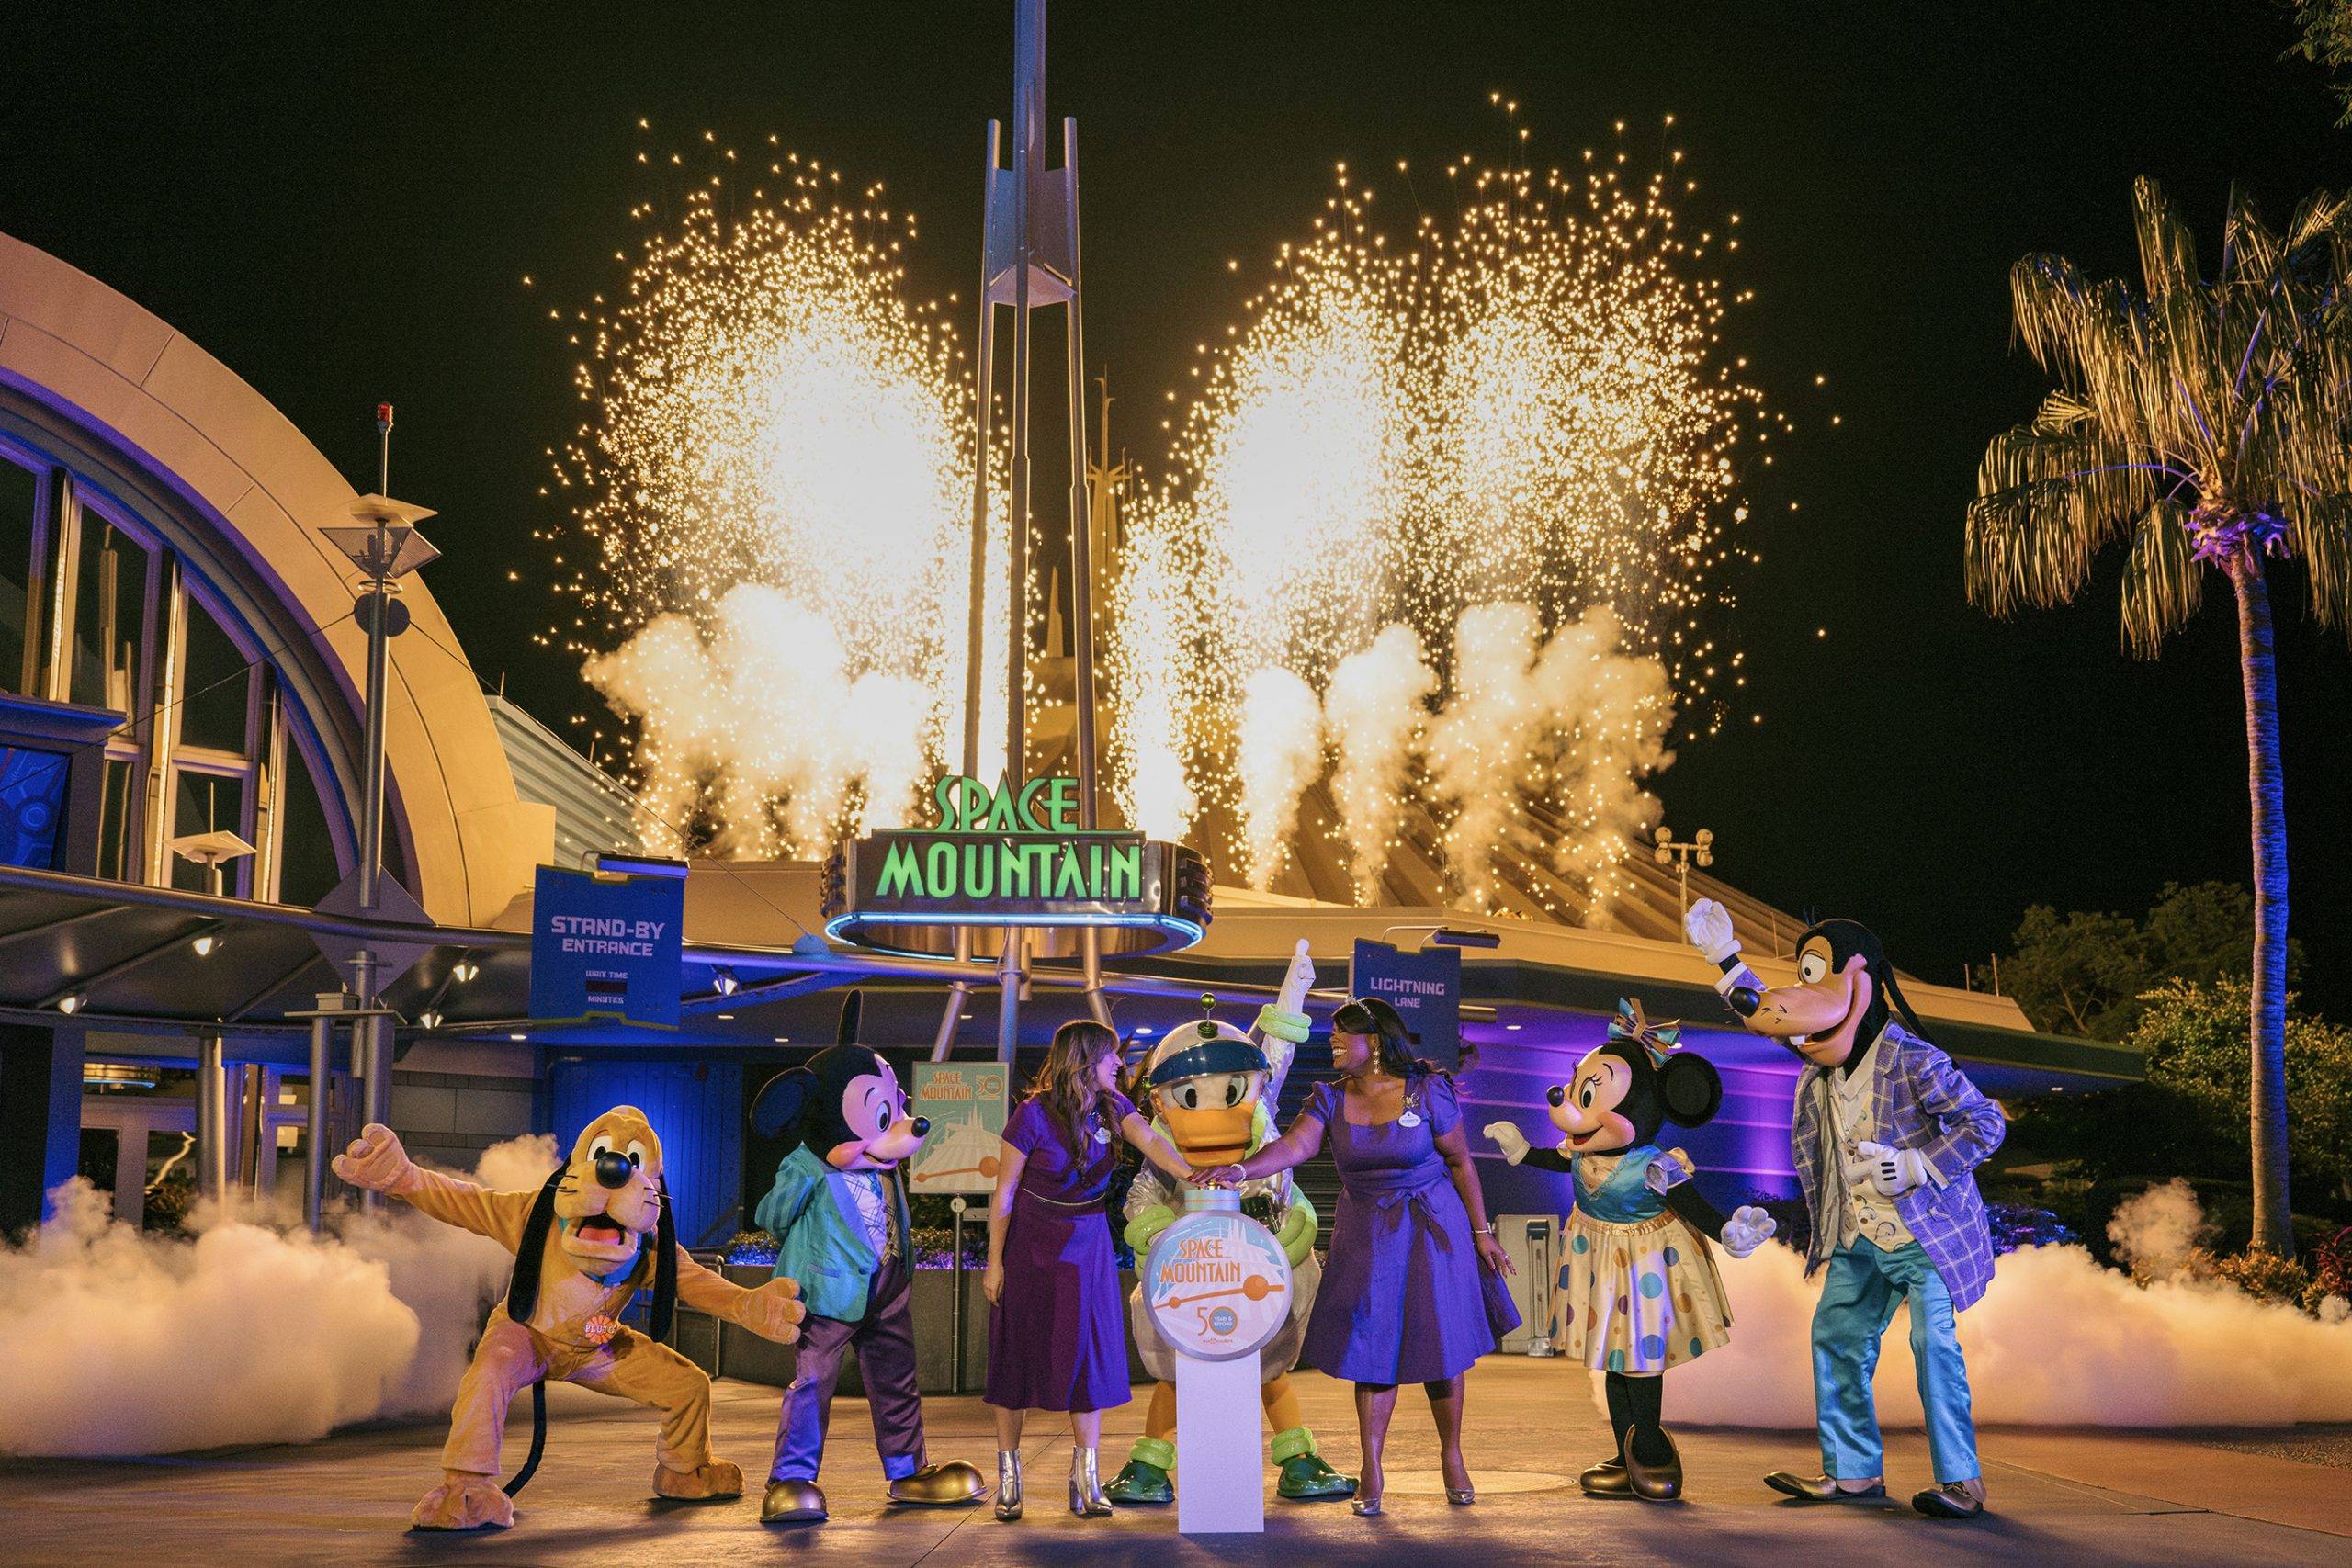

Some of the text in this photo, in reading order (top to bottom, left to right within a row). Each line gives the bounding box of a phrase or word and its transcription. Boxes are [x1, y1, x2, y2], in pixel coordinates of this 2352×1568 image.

[934, 768, 1080, 832] SPACE
[876, 840, 1141, 898] MOUNTAIN
[551, 916, 666, 939] STAND-BY
[562, 938, 654, 956] ENTRANCE
[585, 970, 628, 979] WAIT TIME
[1370, 977, 1445, 996] LIGHTNING
[587, 995, 625, 1004] MINUTES
[1394, 997, 1420, 1008] LANE
[933, 1071, 962, 1083] SPACE
[921, 1083, 972, 1100] MOUNTAIN
[1178, 1238, 1224, 1258] SPACE
[1159, 1261, 1241, 1282] MOUNTAIN
[584, 1325, 616, 1334] PLUTO
[1196, 1305, 1238, 1336] 50
